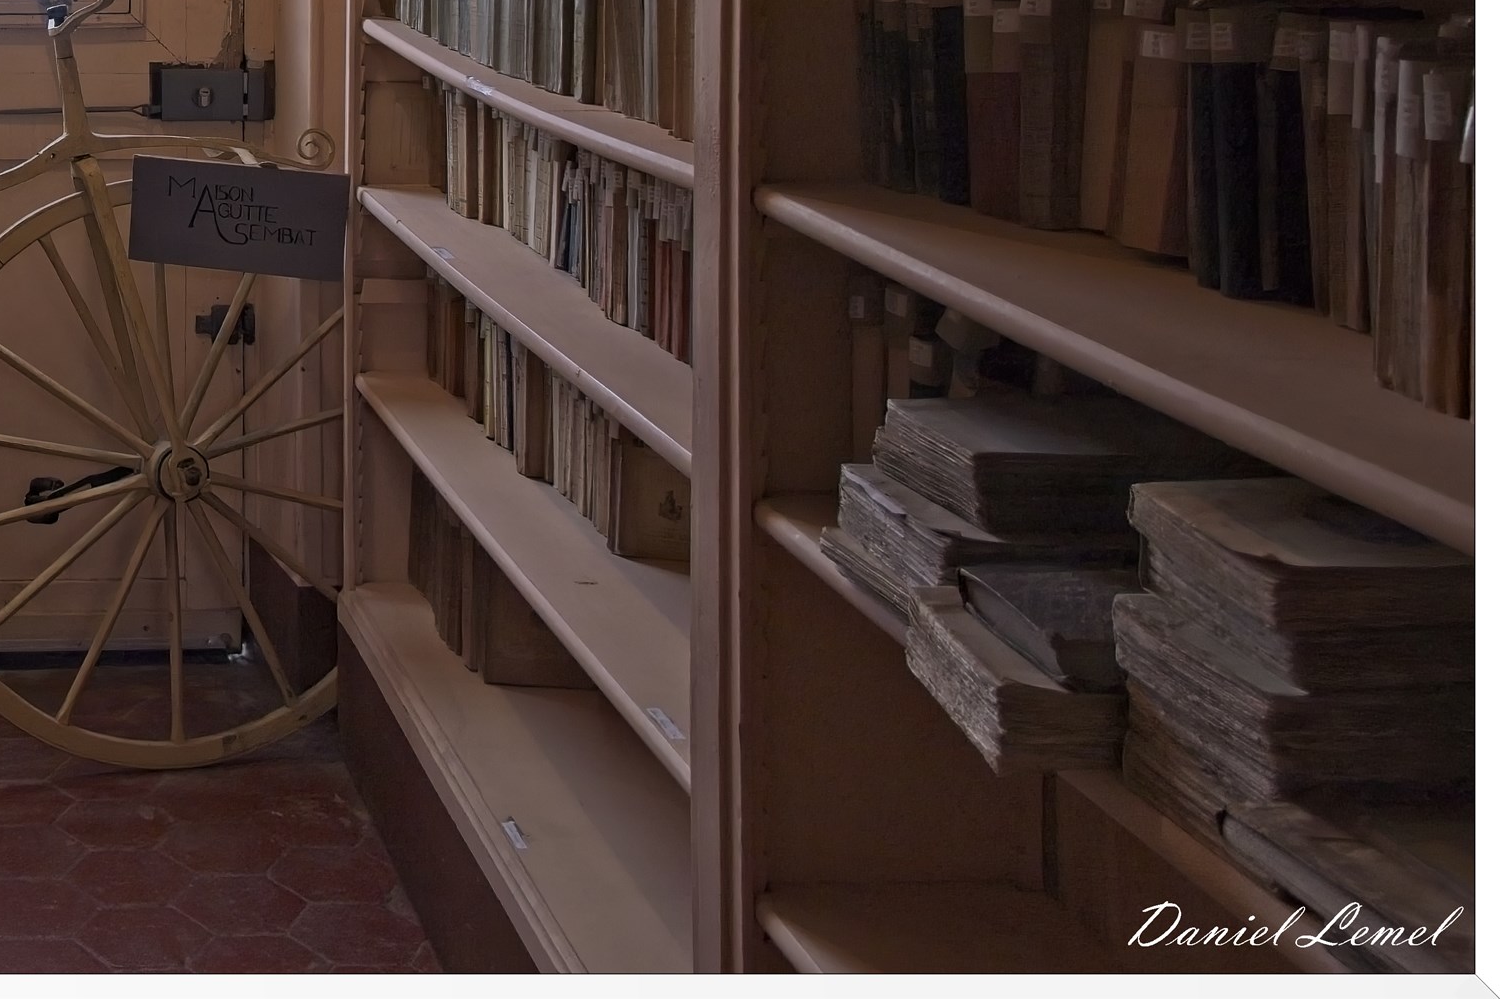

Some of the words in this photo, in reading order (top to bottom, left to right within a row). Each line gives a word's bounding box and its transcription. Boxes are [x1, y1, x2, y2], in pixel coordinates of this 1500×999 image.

[168, 175, 253, 208] MAISON
[188, 184, 279, 228] AGUTTE
[232, 223, 317, 246] SEMBAT
